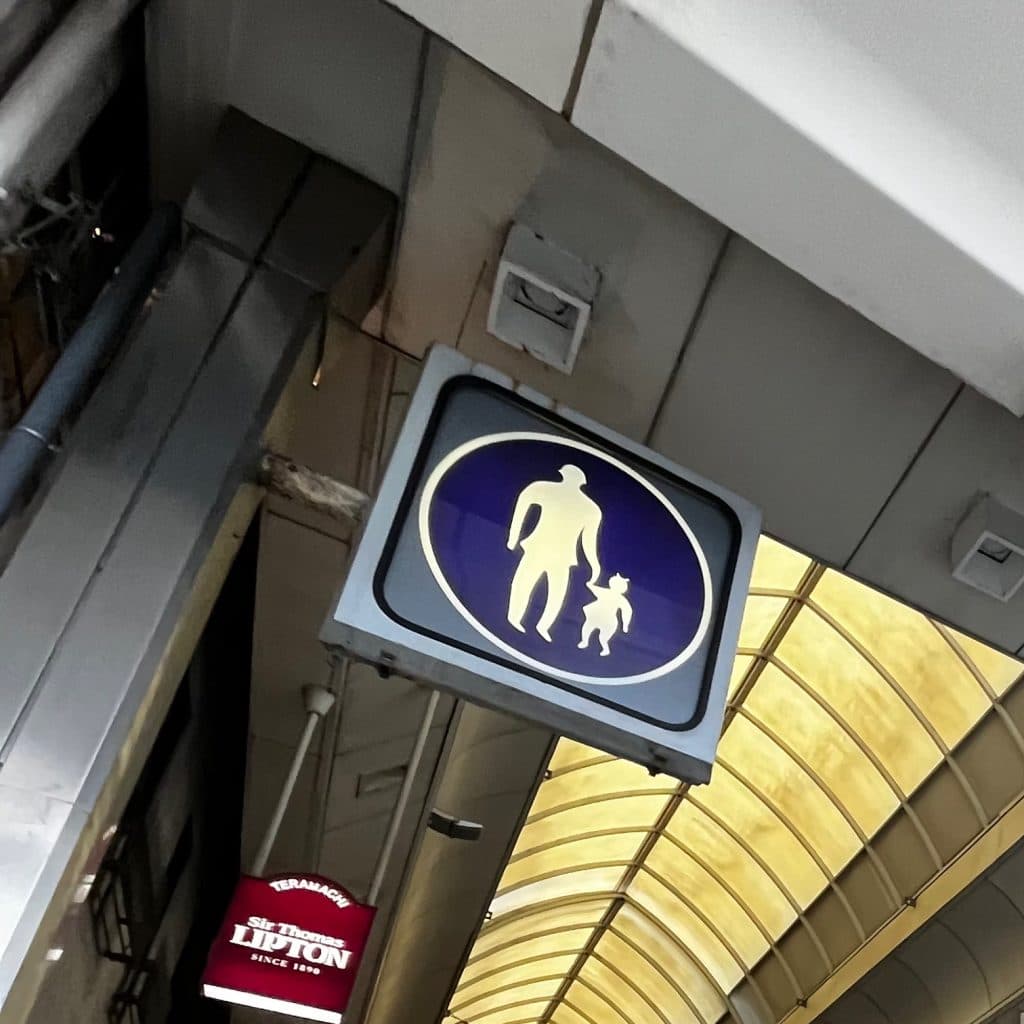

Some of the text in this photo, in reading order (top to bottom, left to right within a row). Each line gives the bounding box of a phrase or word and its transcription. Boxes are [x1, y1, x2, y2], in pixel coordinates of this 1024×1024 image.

[269, 878, 351, 909] TERAMACHI
[229, 923, 352, 970] LIPTON
[247, 915, 345, 948] Sir Thomas
[250, 953, 320, 975] SINCE 1890
